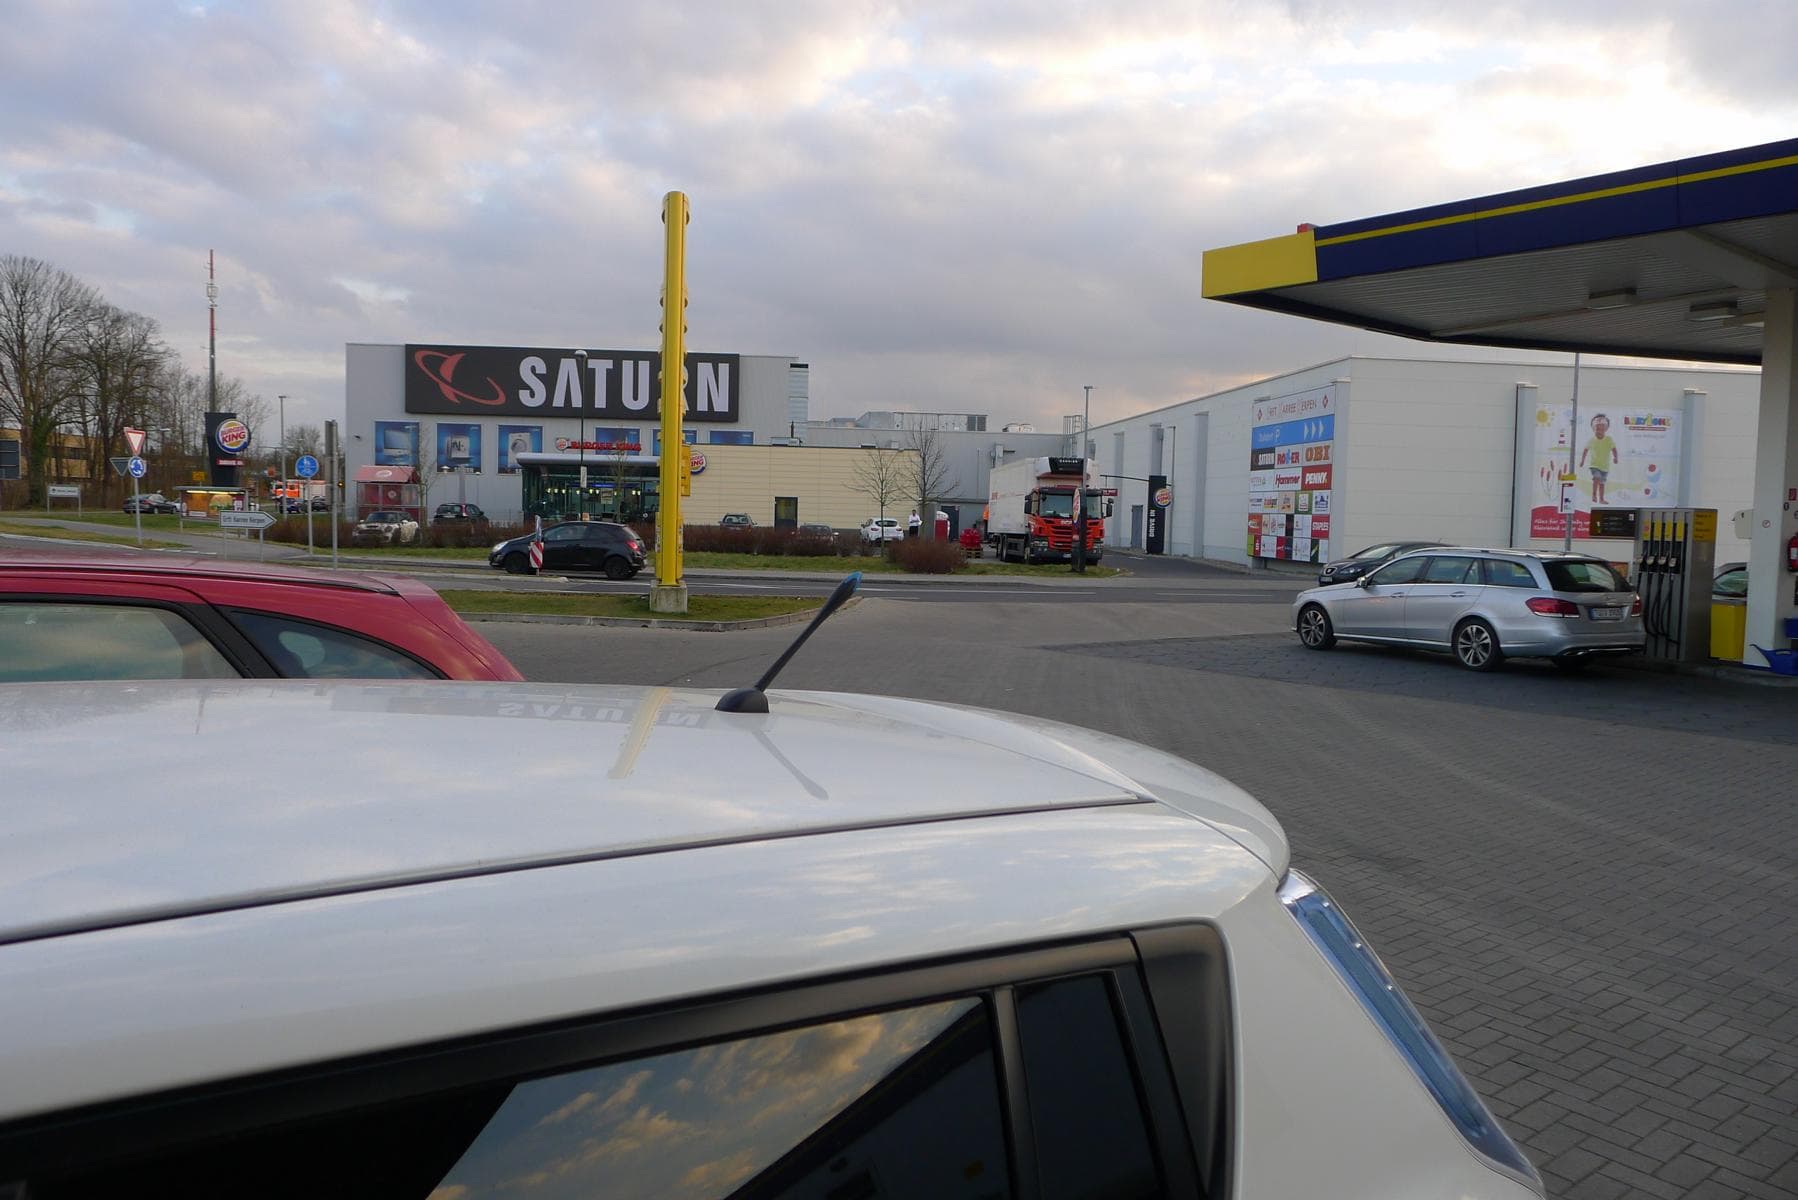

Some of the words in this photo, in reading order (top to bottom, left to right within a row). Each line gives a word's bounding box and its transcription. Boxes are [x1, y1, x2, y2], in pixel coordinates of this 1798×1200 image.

[222, 431, 246, 443] KING
[1305, 445, 1330, 461] OBI
[1275, 474, 1301, 488] Hammer
